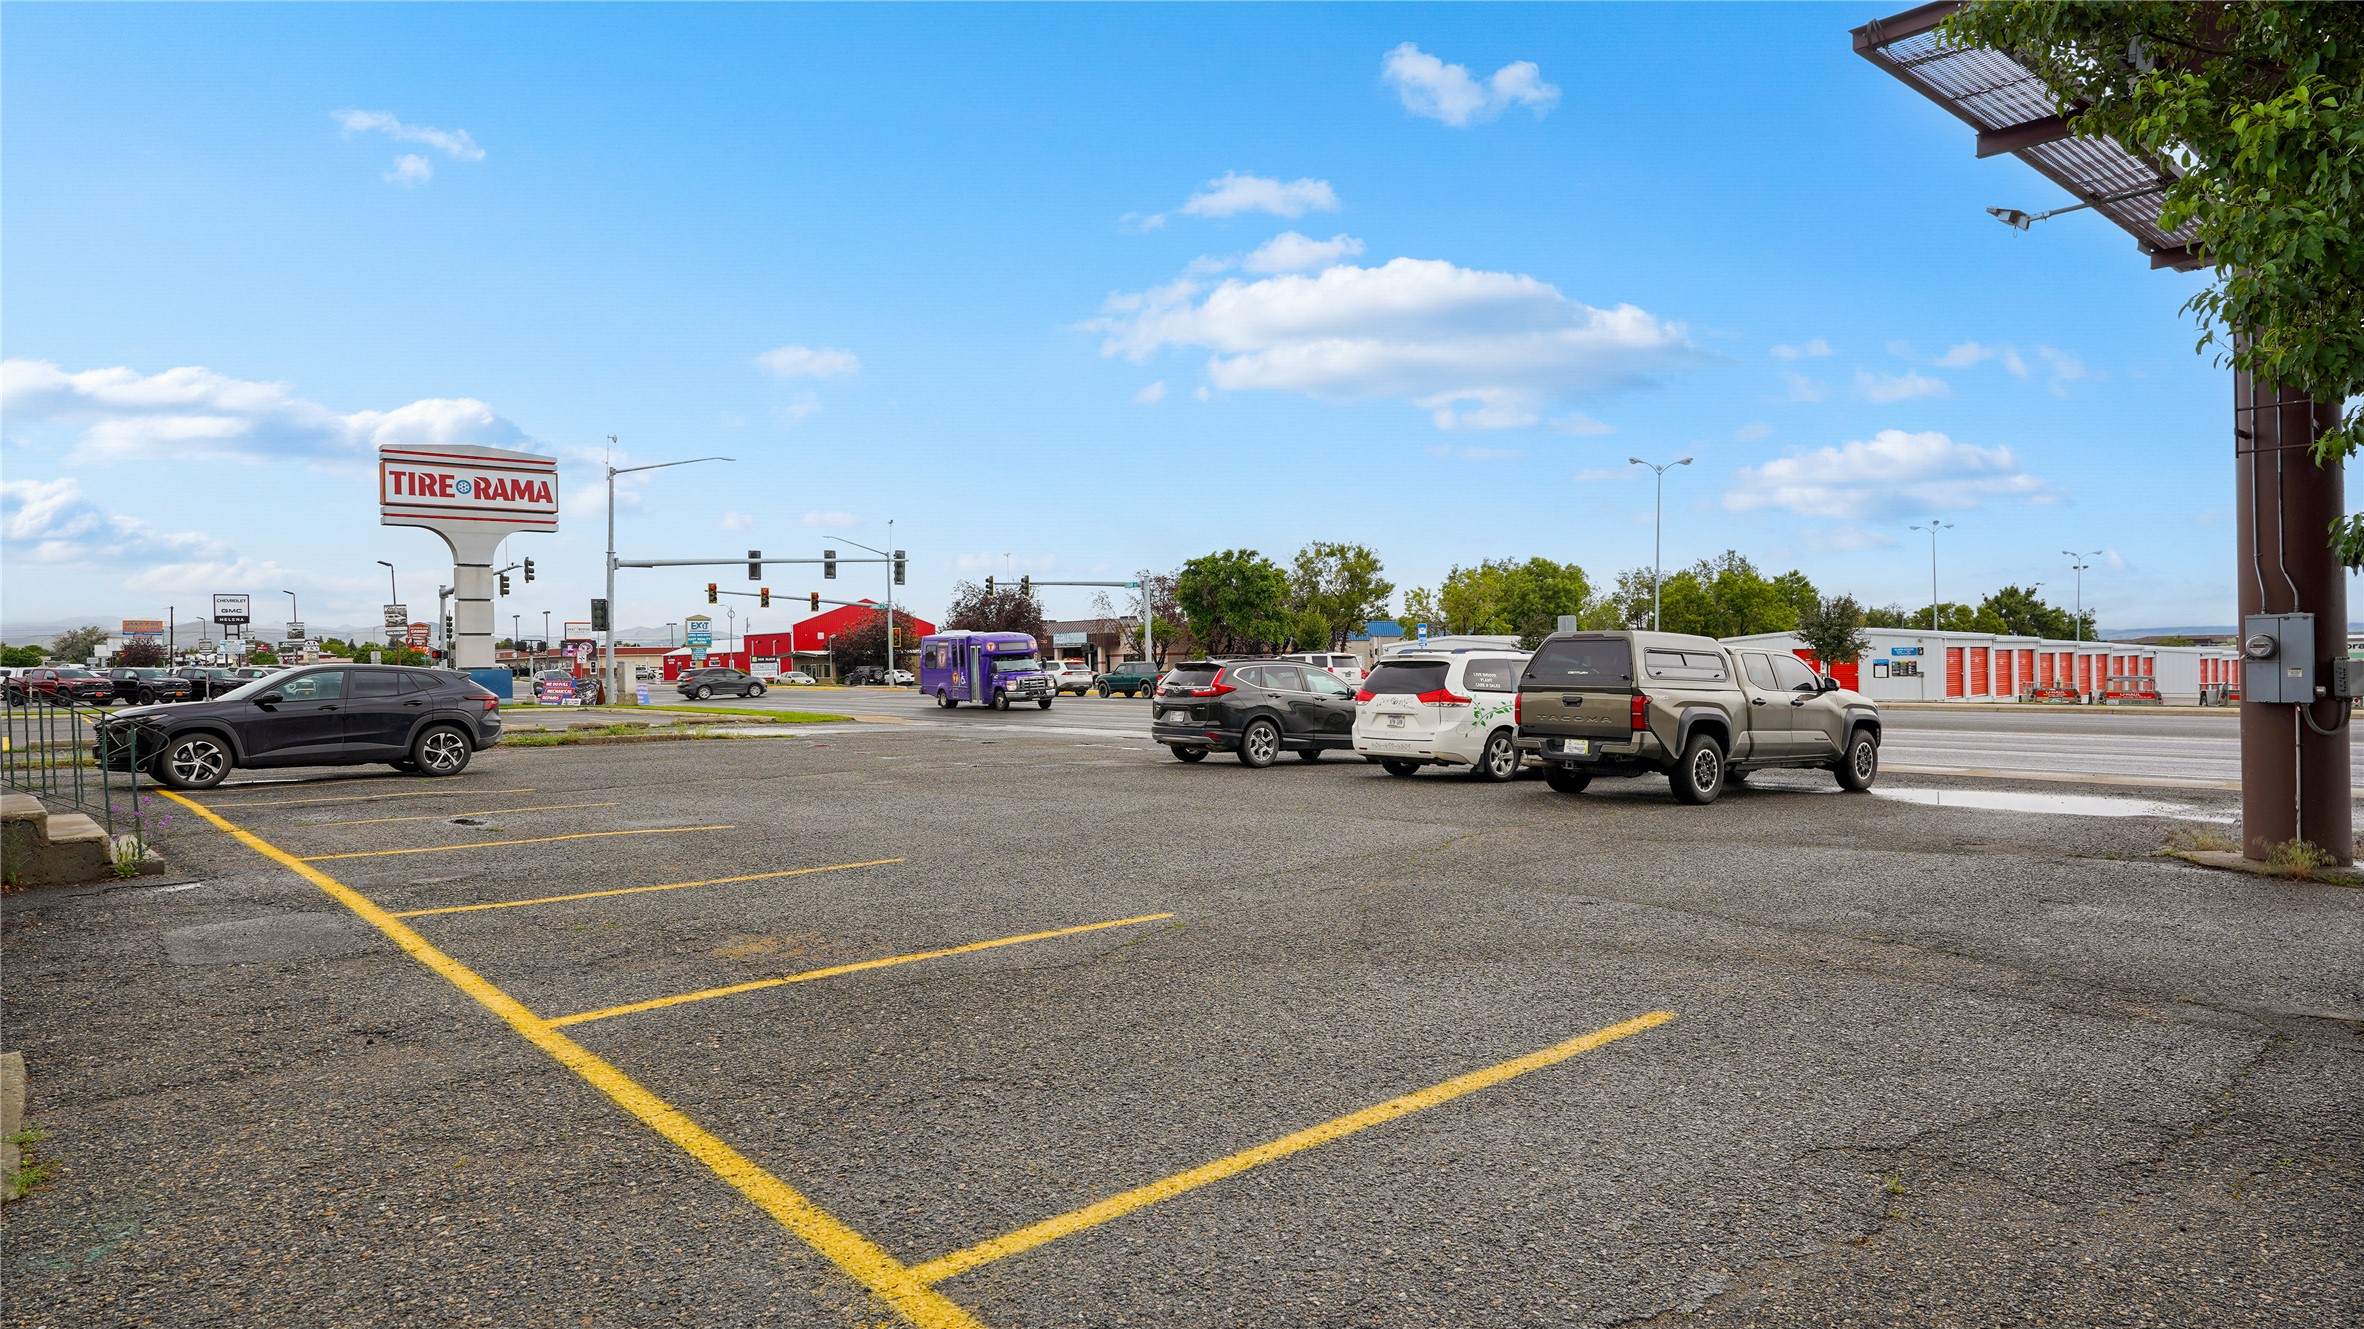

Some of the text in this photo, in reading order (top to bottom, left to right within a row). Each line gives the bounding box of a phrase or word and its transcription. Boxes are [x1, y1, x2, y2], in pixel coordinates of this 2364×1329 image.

[388, 470, 554, 504] TIRE RAMA
[1536, 714, 1612, 723] TACOMA
